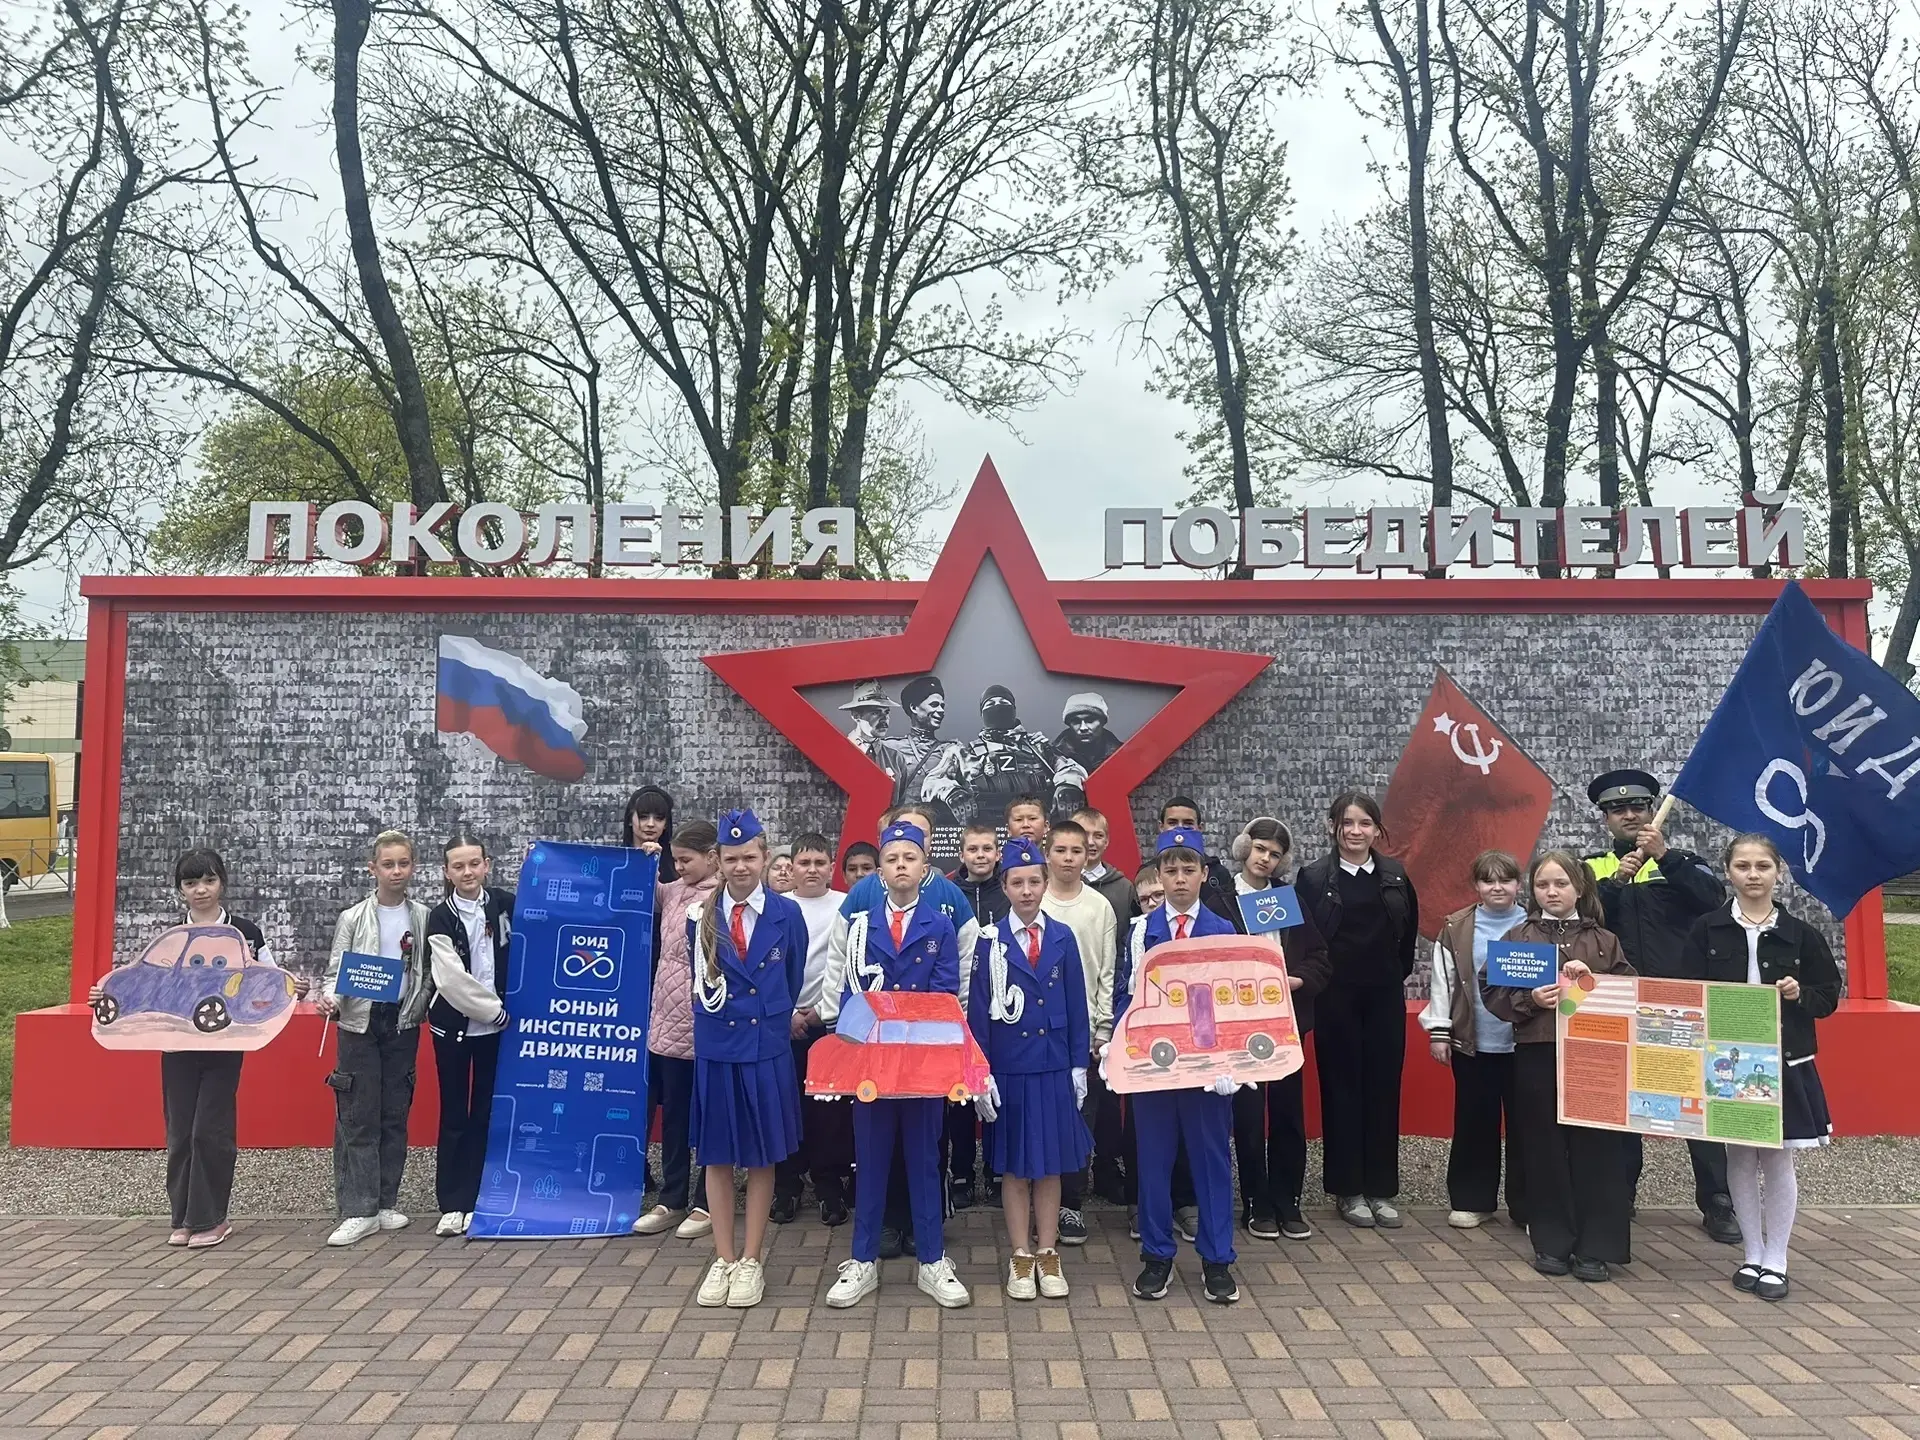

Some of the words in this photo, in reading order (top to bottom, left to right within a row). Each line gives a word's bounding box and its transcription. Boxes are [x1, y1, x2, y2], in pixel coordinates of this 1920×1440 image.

[248, 499, 856, 567] ПОКОЛЕНИЯ
[1105, 489, 1805, 574] ПОБЕДИТЕЛЕЙ
[1255, 895, 1279, 906] ЮИД
[571, 935, 609, 949] ЮИД
[360, 963, 383, 971] ЮНЫЕ
[1496, 957, 1548, 966] ИНСПЕКТОРЫ
[346, 967, 394, 980] ИНСПЕКТОРЫ
[1501, 964, 1544, 972] ДВИЖЕНИЯ
[349, 974, 389, 986] ДВИЖЕНИЯ
[1506, 971, 1538, 979] РОССИИ
[353, 982, 382, 991] РОССИИ
[549, 998, 619, 1018] ЮНЫЙ
[518, 1018, 642, 1041] ИНСПЕКТОР
[519, 1040, 638, 1063] ДВИЖЕНИЯ
